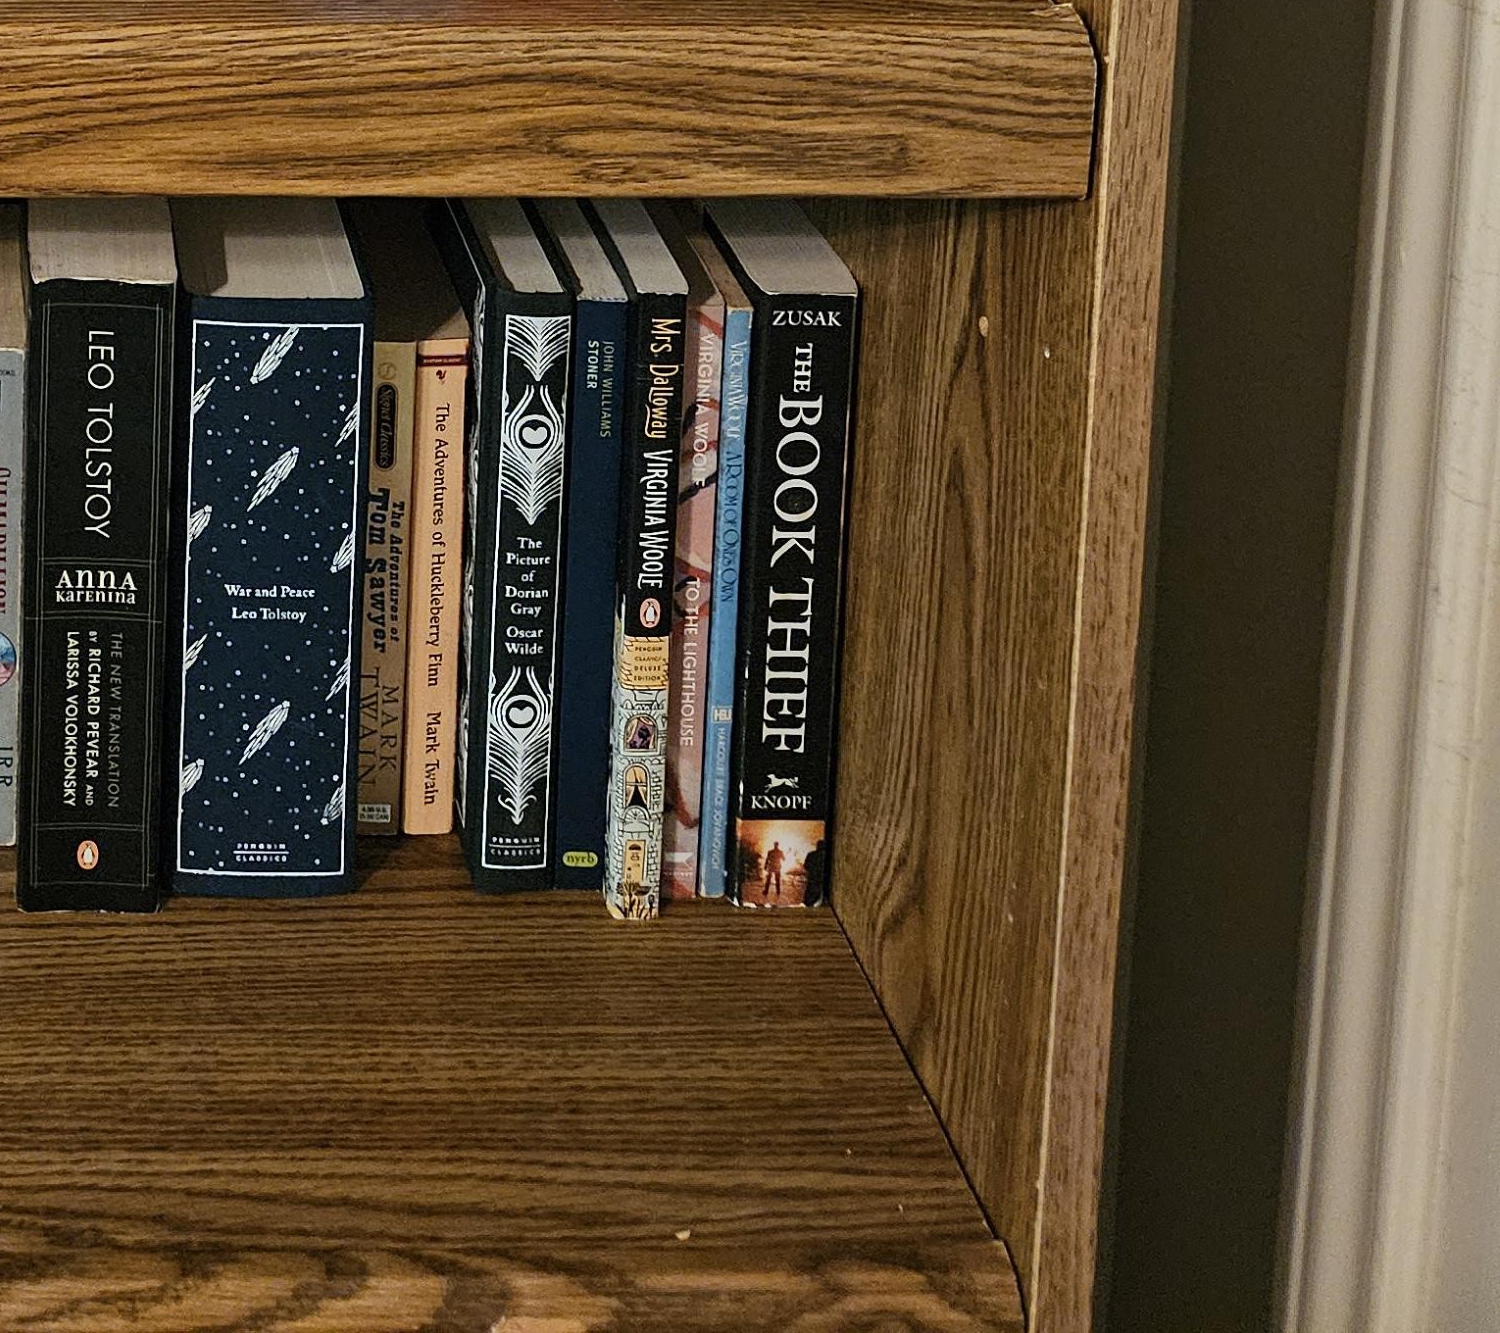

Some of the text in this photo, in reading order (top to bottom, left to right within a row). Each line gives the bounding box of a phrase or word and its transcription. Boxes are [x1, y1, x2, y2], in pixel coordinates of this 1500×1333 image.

[772, 310, 842, 327] ZUSAK
[586, 340, 599, 389] STONER
[599, 340, 616, 438] JOHN WILLIAMS
[84, 330, 114, 538] LEO TOLSTOY
[762, 343, 822, 754] THE BOOK THIEF
[224, 584, 315, 598] War and Peace
[232, 607, 306, 623] Leo Tolstoy
[424, 403, 450, 805] The Adventures of Huckleberry Finn Mark Twain
[62, 631, 79, 806] LARISSA VOLOKHONSKY
[751, 795, 812, 810] KNOPF
[567, 854, 594, 865] nyrb
